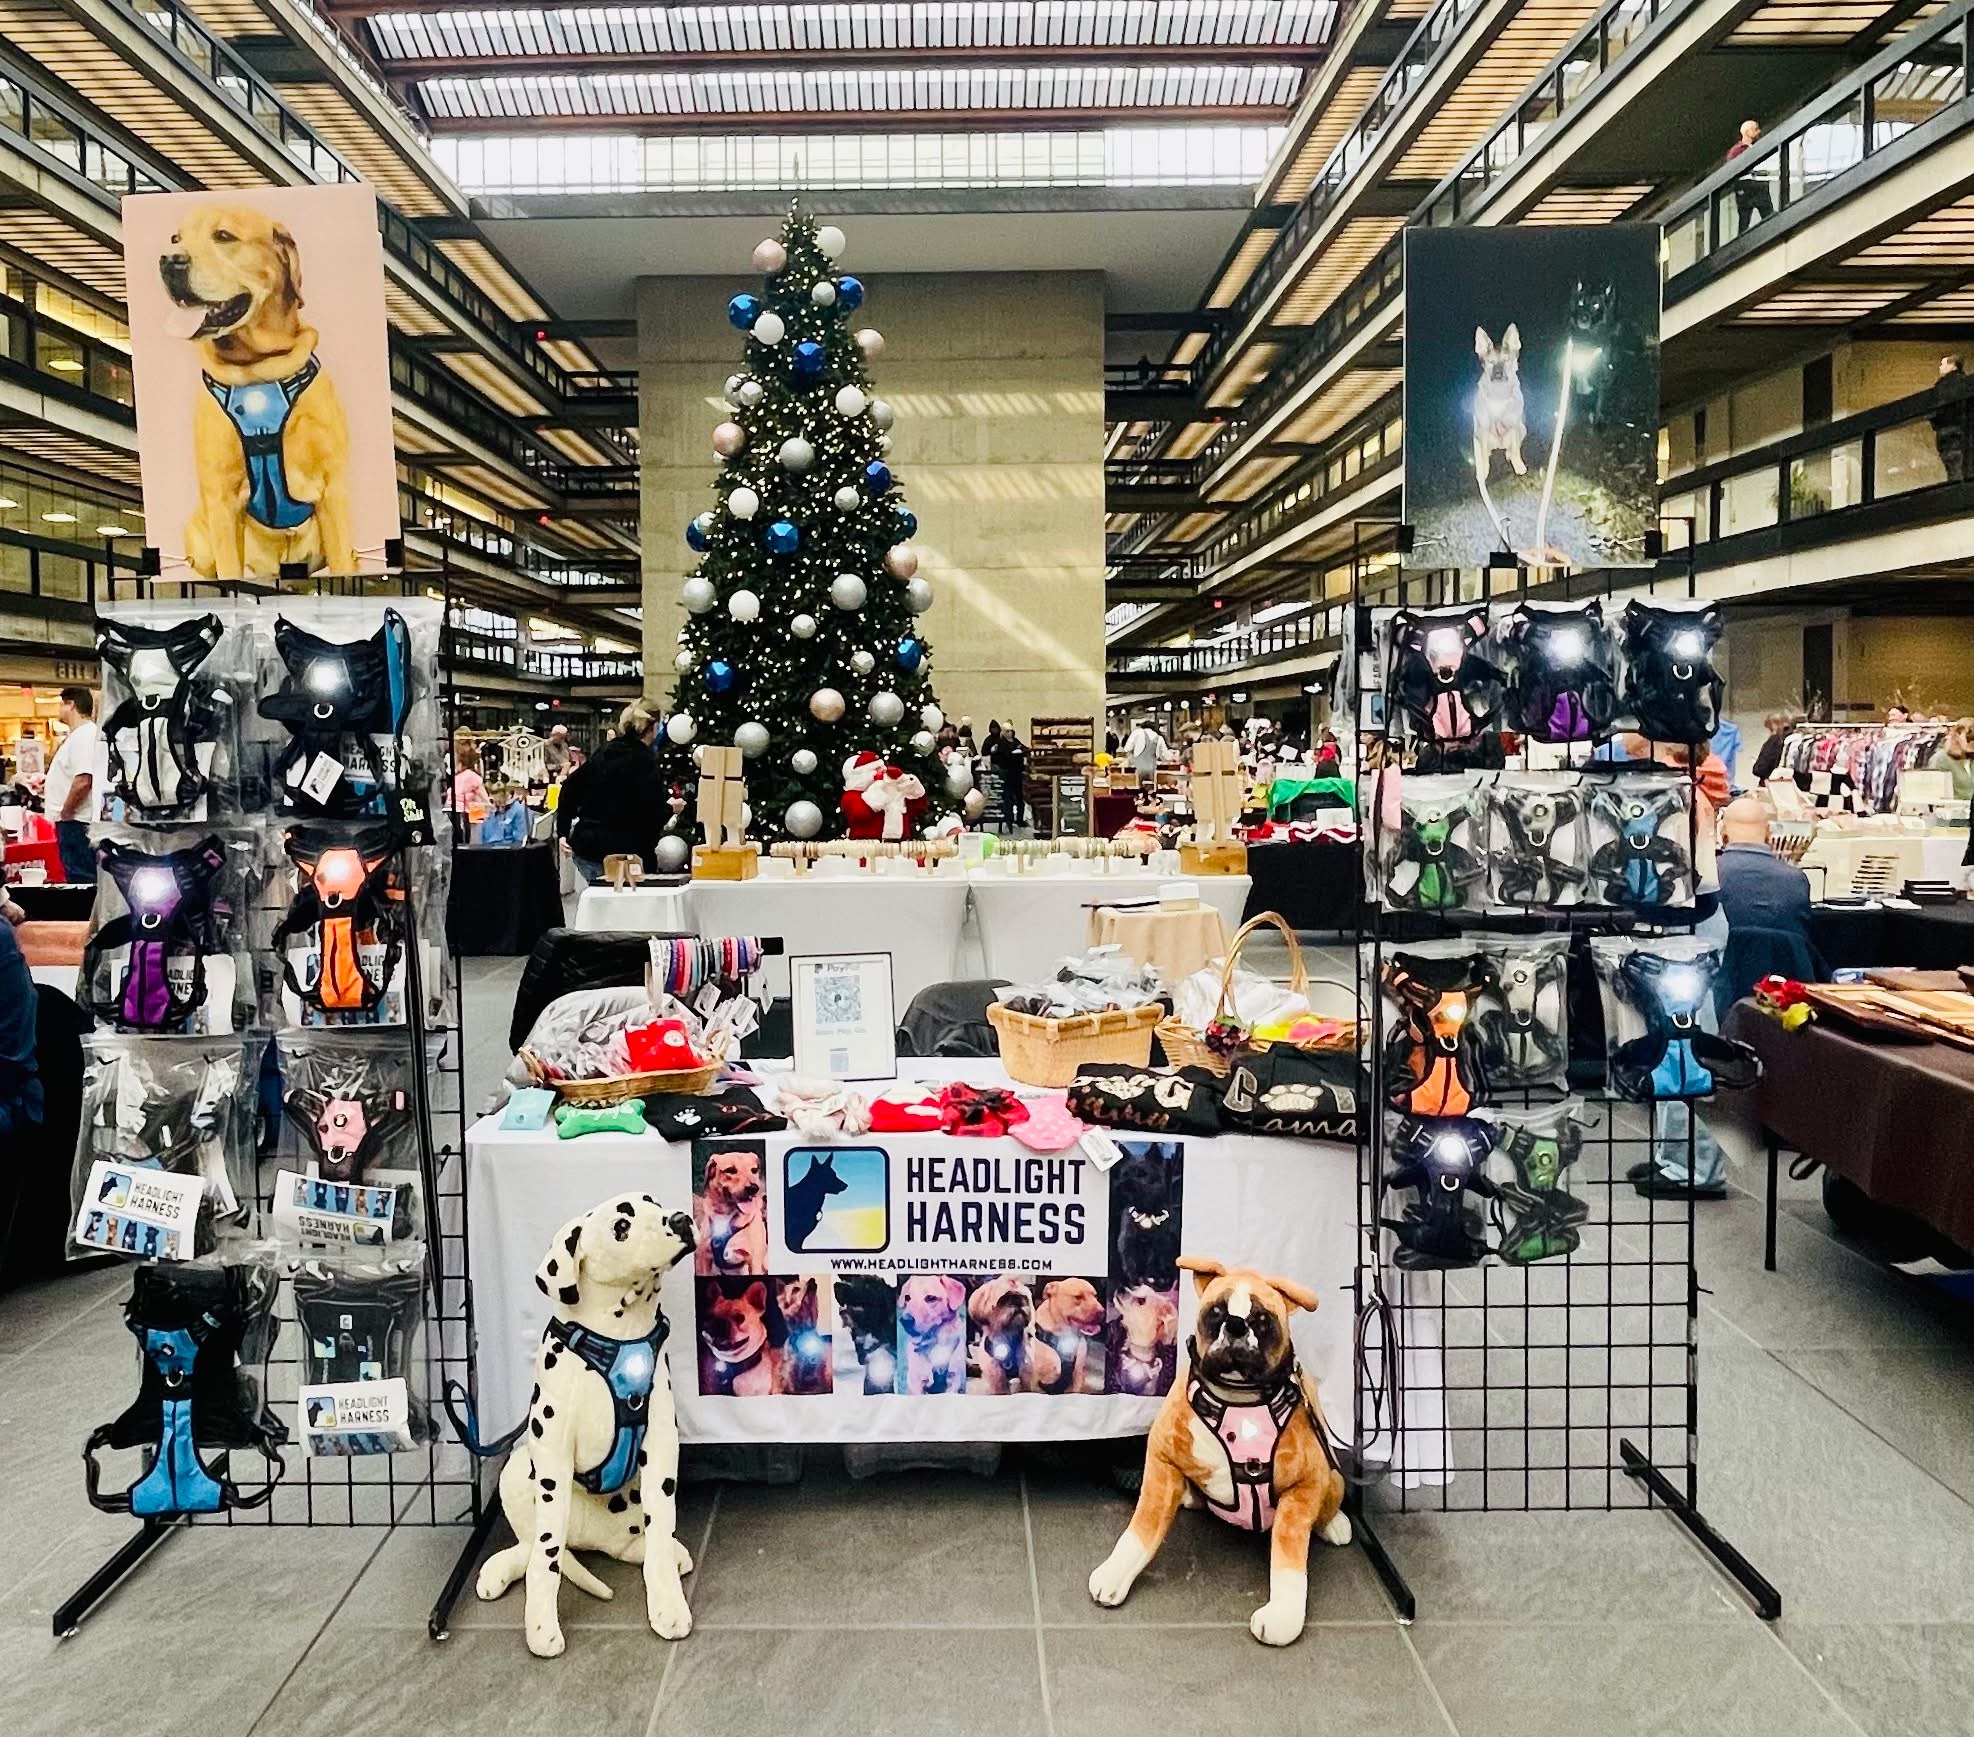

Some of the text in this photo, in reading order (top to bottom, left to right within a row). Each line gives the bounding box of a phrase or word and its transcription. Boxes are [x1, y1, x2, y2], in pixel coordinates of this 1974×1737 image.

[907, 1156, 1087, 1195] HEADLIGHT
[134, 1182, 184, 1203] HEADLIGHT
[131, 1195, 181, 1219] HARNESS
[298, 1215, 350, 1234] HARNESS
[907, 1201, 1086, 1245] HARNESS
[830, 1258, 1053, 1271] WWW.HEADLIGHTHARNESS.COM
[338, 1396, 388, 1410] HEADLIGHT
[340, 1409, 390, 1424] HARNESS
